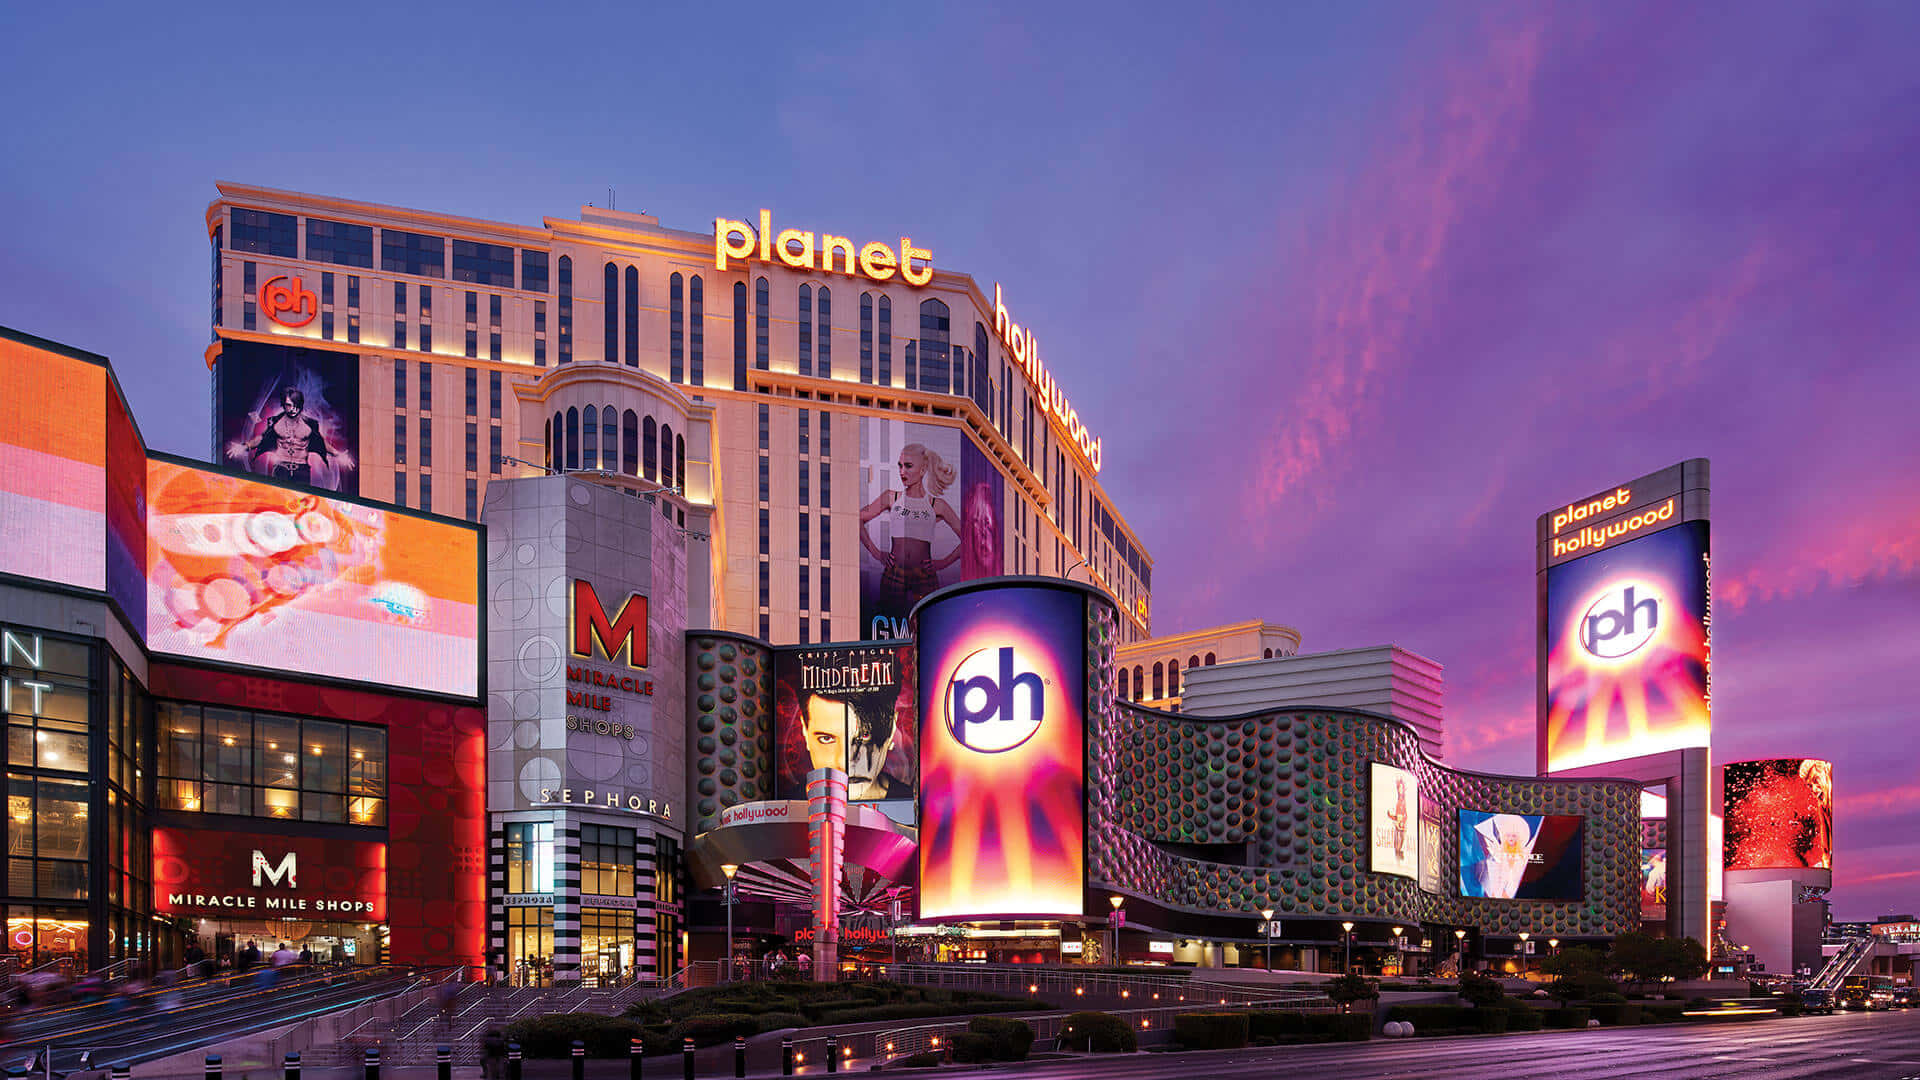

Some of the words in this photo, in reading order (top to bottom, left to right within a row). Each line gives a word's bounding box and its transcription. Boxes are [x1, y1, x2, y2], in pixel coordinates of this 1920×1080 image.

[715, 208, 934, 287] planet
[262, 276, 317, 324] ph
[994, 281, 1102, 473] hollywood
[1553, 487, 1631, 534] planet
[1553, 498, 1674, 557] hollywood
[570, 578, 649, 671] M
[1587, 585, 1658, 655] ph
[566, 666, 654, 696] MIRACLE
[803, 662, 892, 690] MINDFREAK
[566, 690, 612, 711] MILE
[949, 646, 1045, 745] ph
[566, 715, 635, 740] SHOPS
[541, 788, 671, 817] SEPHORA
[733, 804, 788, 822] hollywood
[252, 850, 297, 888] M
[168, 893, 256, 908] MIRACLE
[266, 897, 307, 910] MILE
[315, 899, 375, 912] SHOPS
[504, 895, 553, 905] SEPHORA
[795, 927, 815, 943] pla
[844, 926, 889, 943] hollyw
